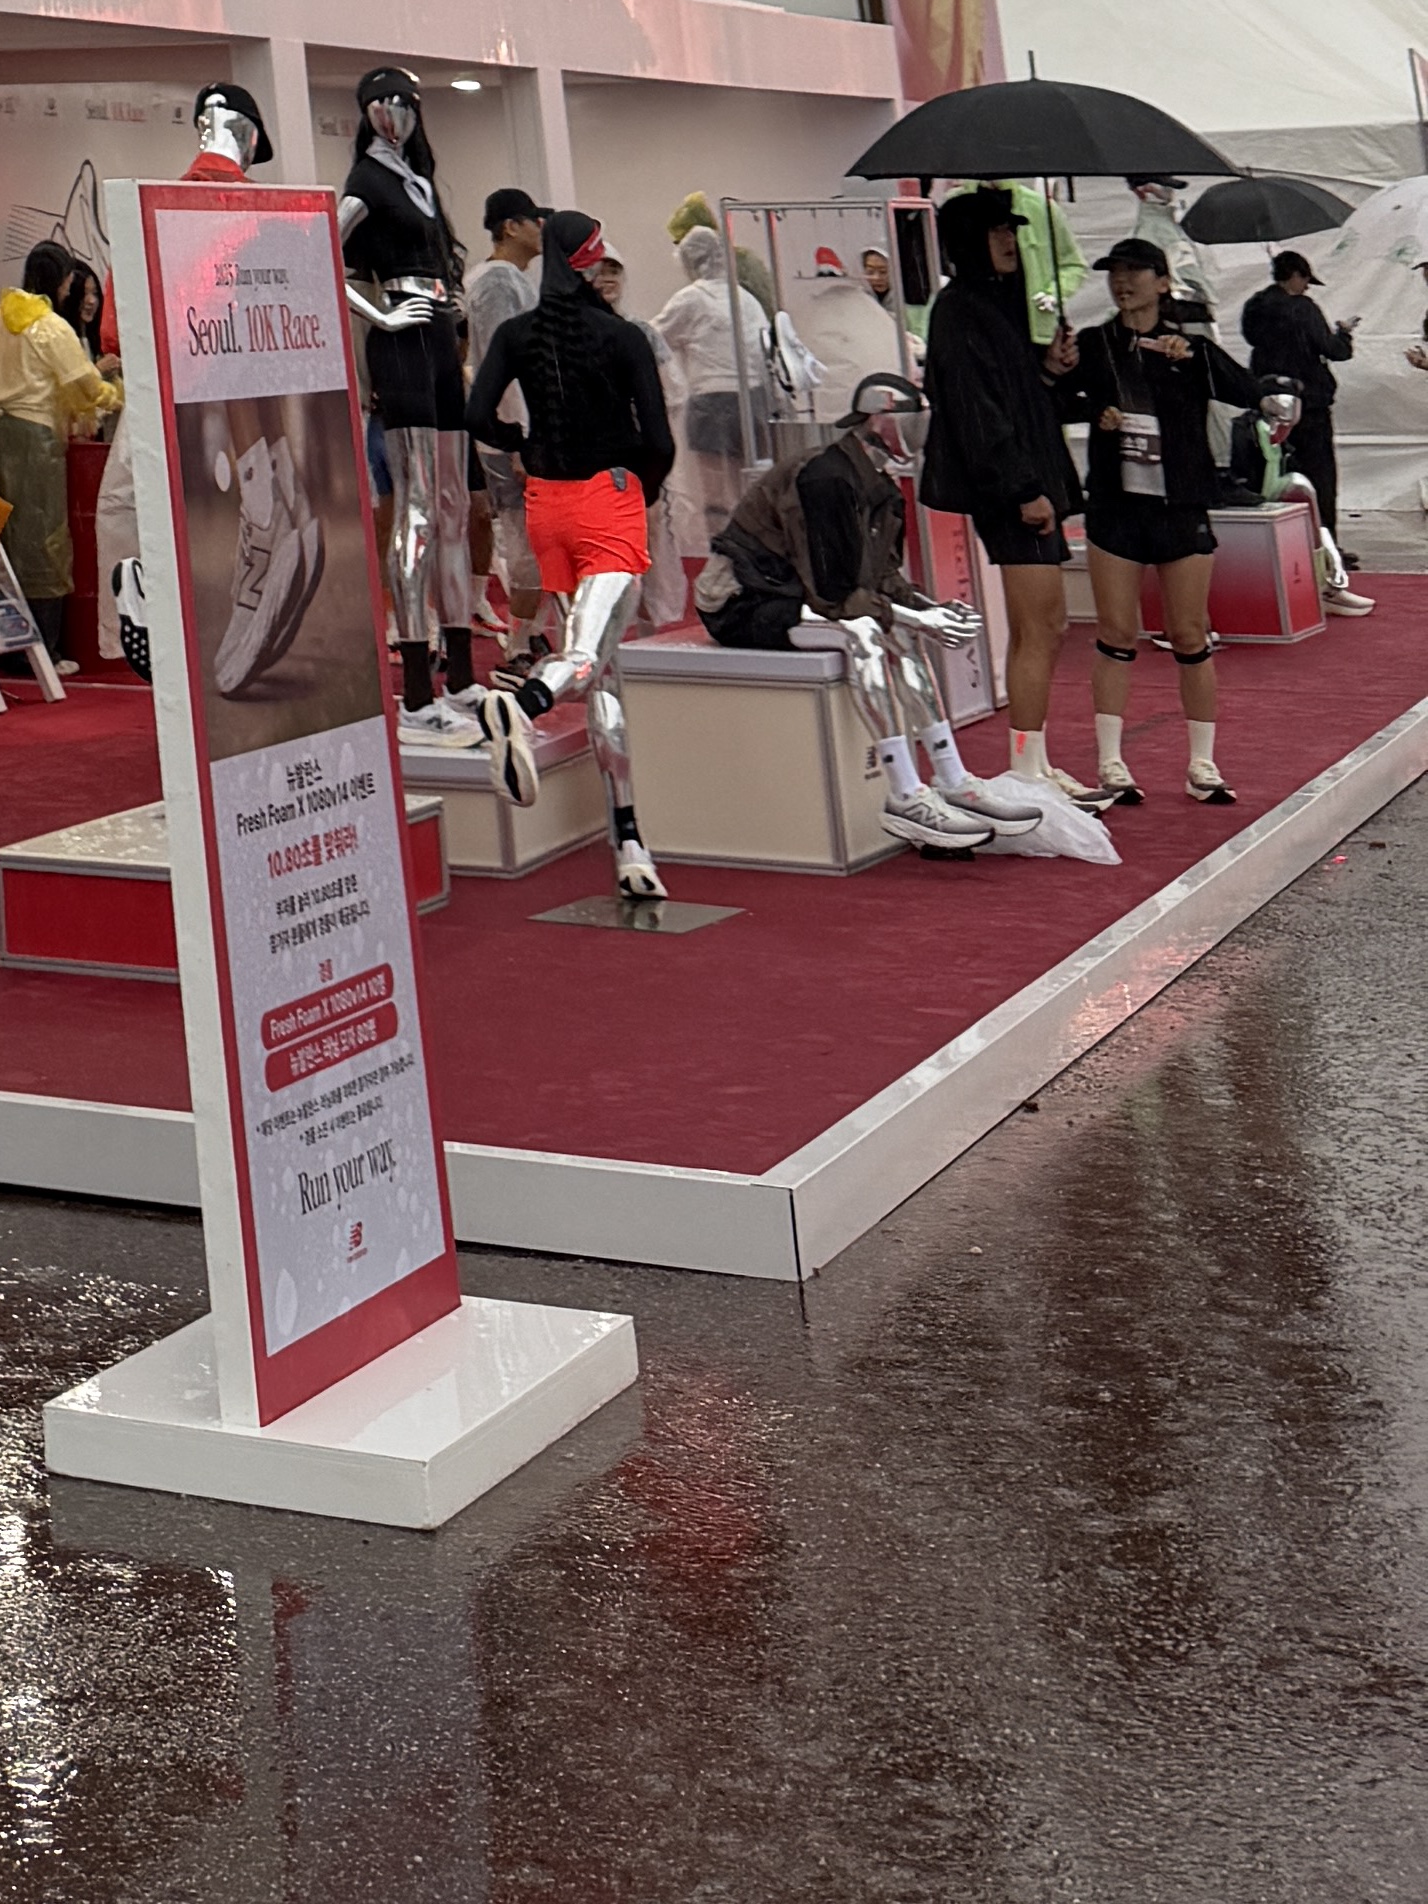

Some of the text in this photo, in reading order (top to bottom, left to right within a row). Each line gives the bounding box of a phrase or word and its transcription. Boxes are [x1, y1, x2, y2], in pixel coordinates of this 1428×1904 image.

[186, 302, 327, 357] Seoul. 10K Race.
[236, 806, 267, 837] Fresh
[296, 795, 306, 817] X
[298, 1171, 332, 1215] Run
[333, 1153, 364, 1211] your
